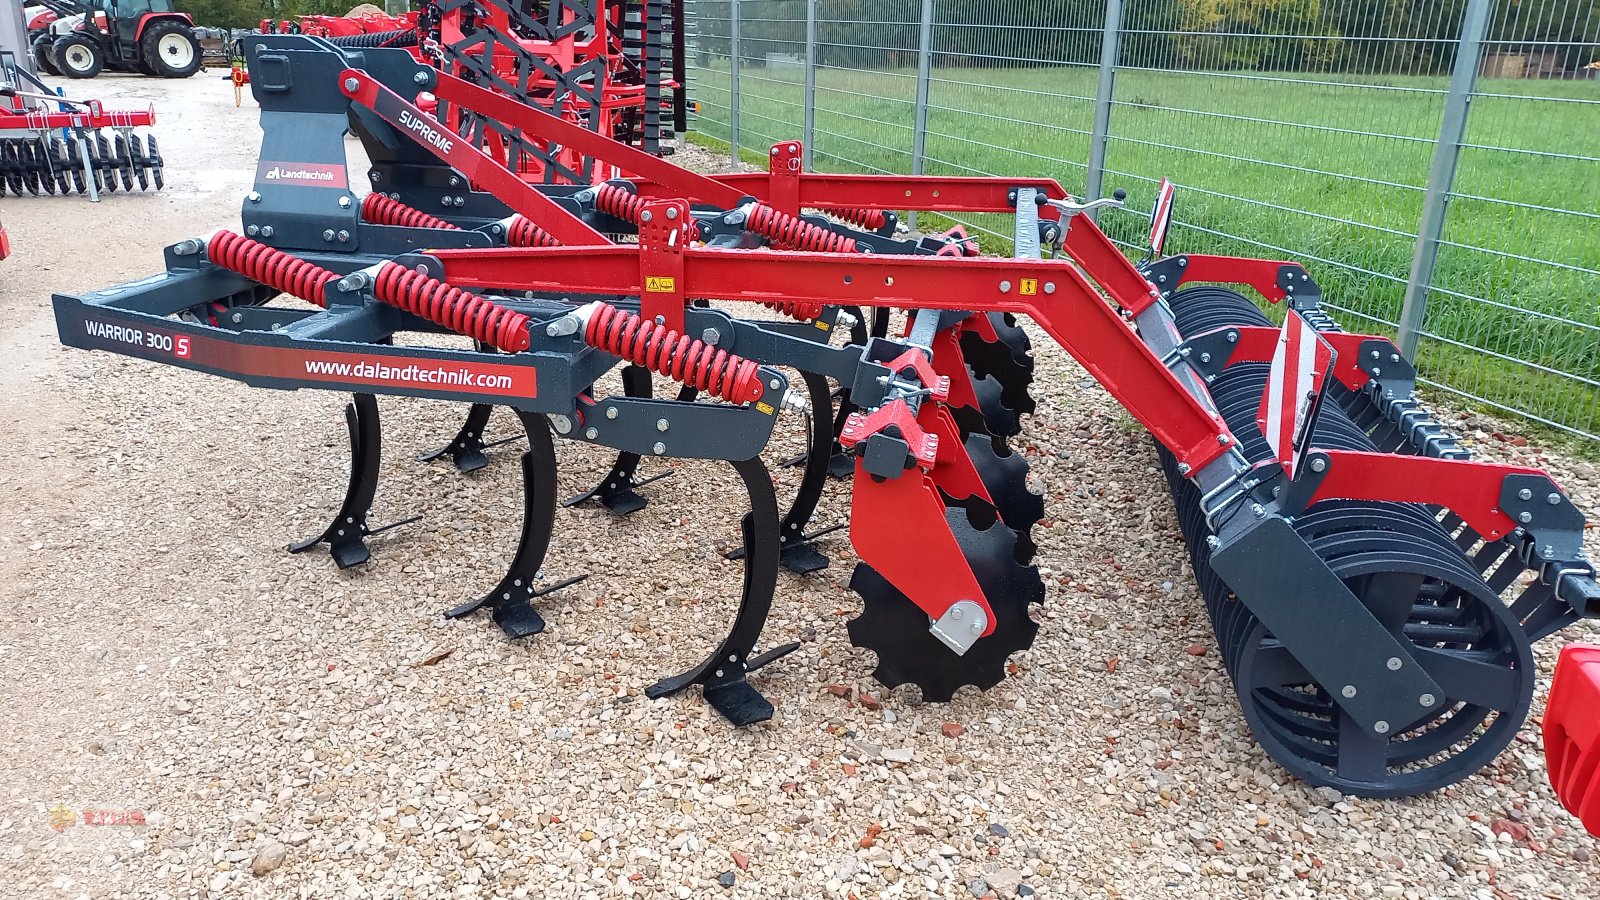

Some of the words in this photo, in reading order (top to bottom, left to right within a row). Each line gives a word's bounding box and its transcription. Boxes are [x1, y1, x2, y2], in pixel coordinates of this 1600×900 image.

[398, 109, 454, 155] SUPREME
[280, 168, 334, 181] Landtechnik
[85, 319, 143, 346] WARRIOR
[146, 332, 173, 352] 300
[177, 338, 189, 356] S
[305, 360, 512, 389] www.dalandtechnik.com
